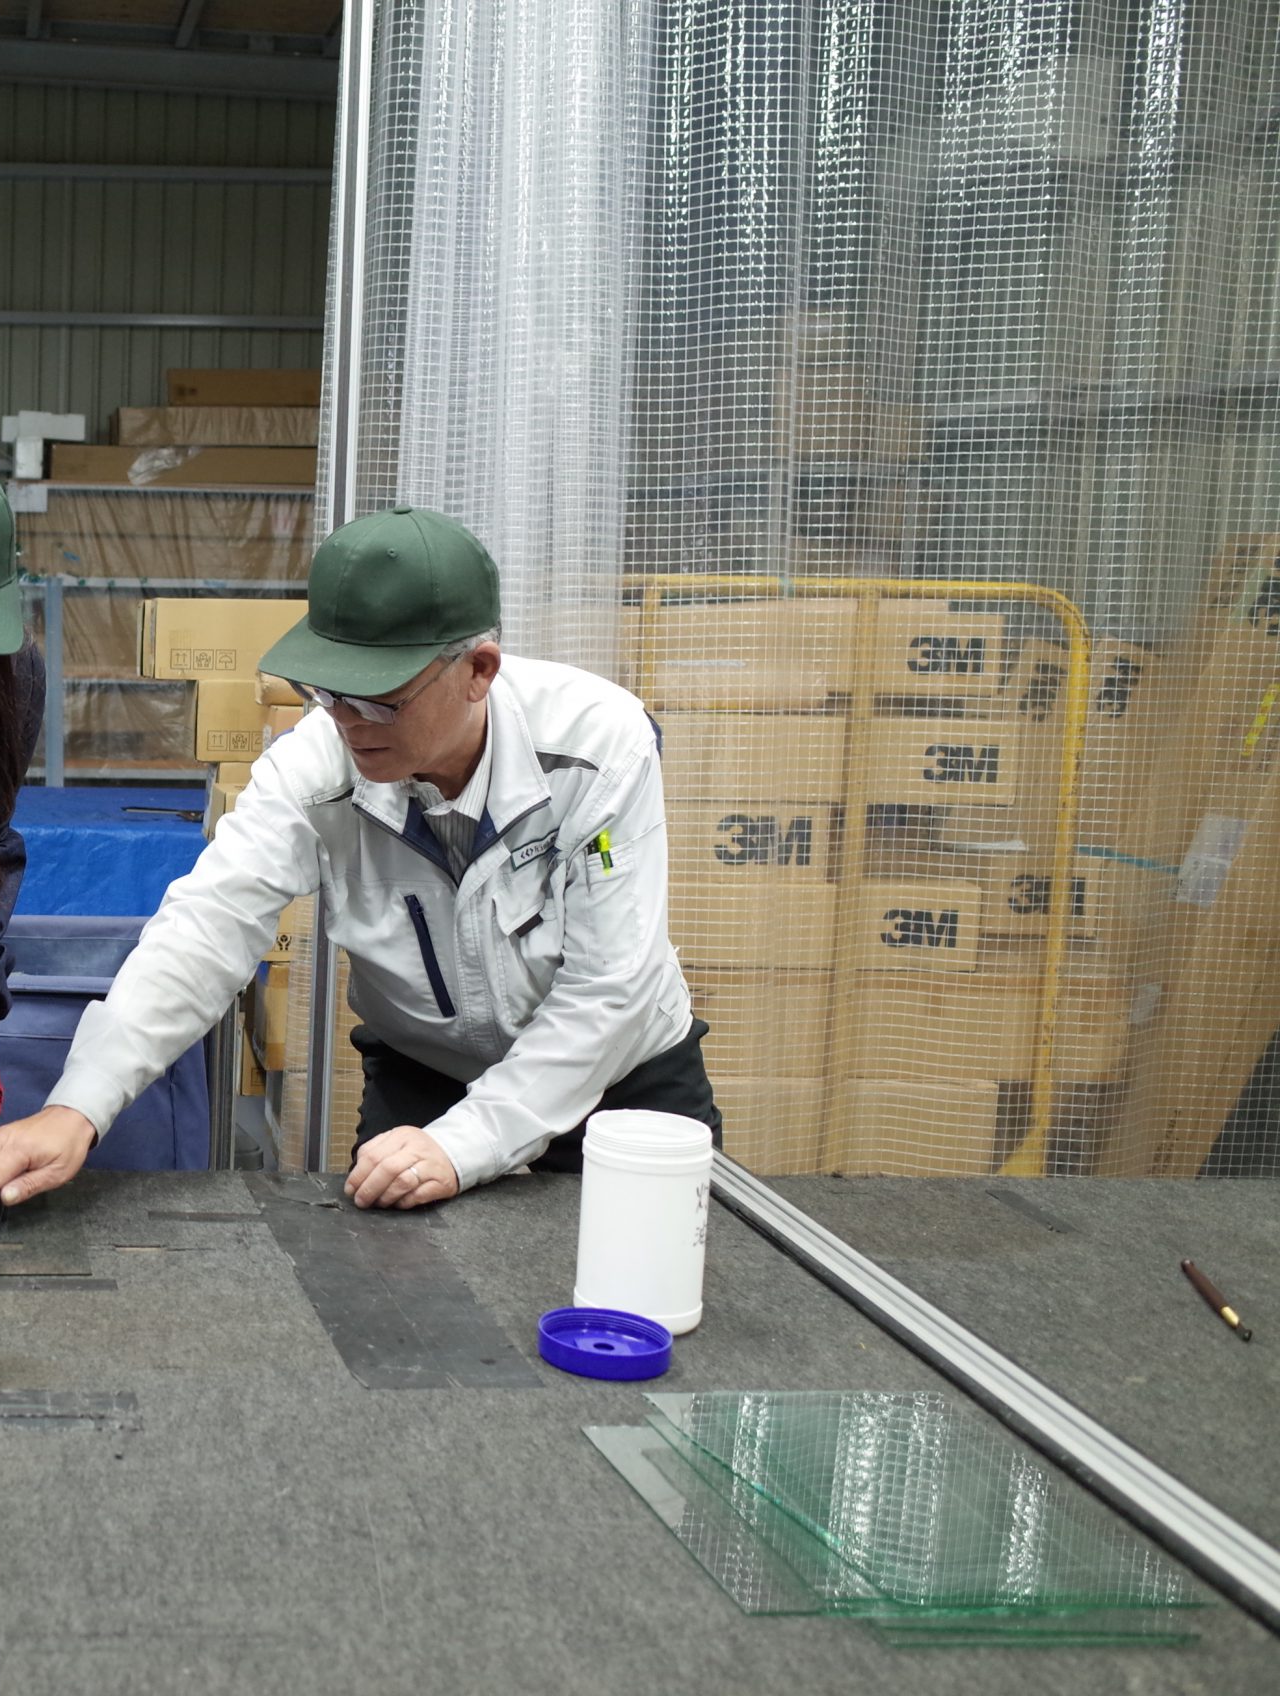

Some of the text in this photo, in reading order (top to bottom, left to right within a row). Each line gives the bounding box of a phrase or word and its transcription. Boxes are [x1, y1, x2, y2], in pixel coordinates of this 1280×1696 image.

[907, 637, 985, 674] 3M
[923, 745, 999, 783] 3M
[714, 814, 813, 866] 3M
[881, 909, 960, 948] 3M
